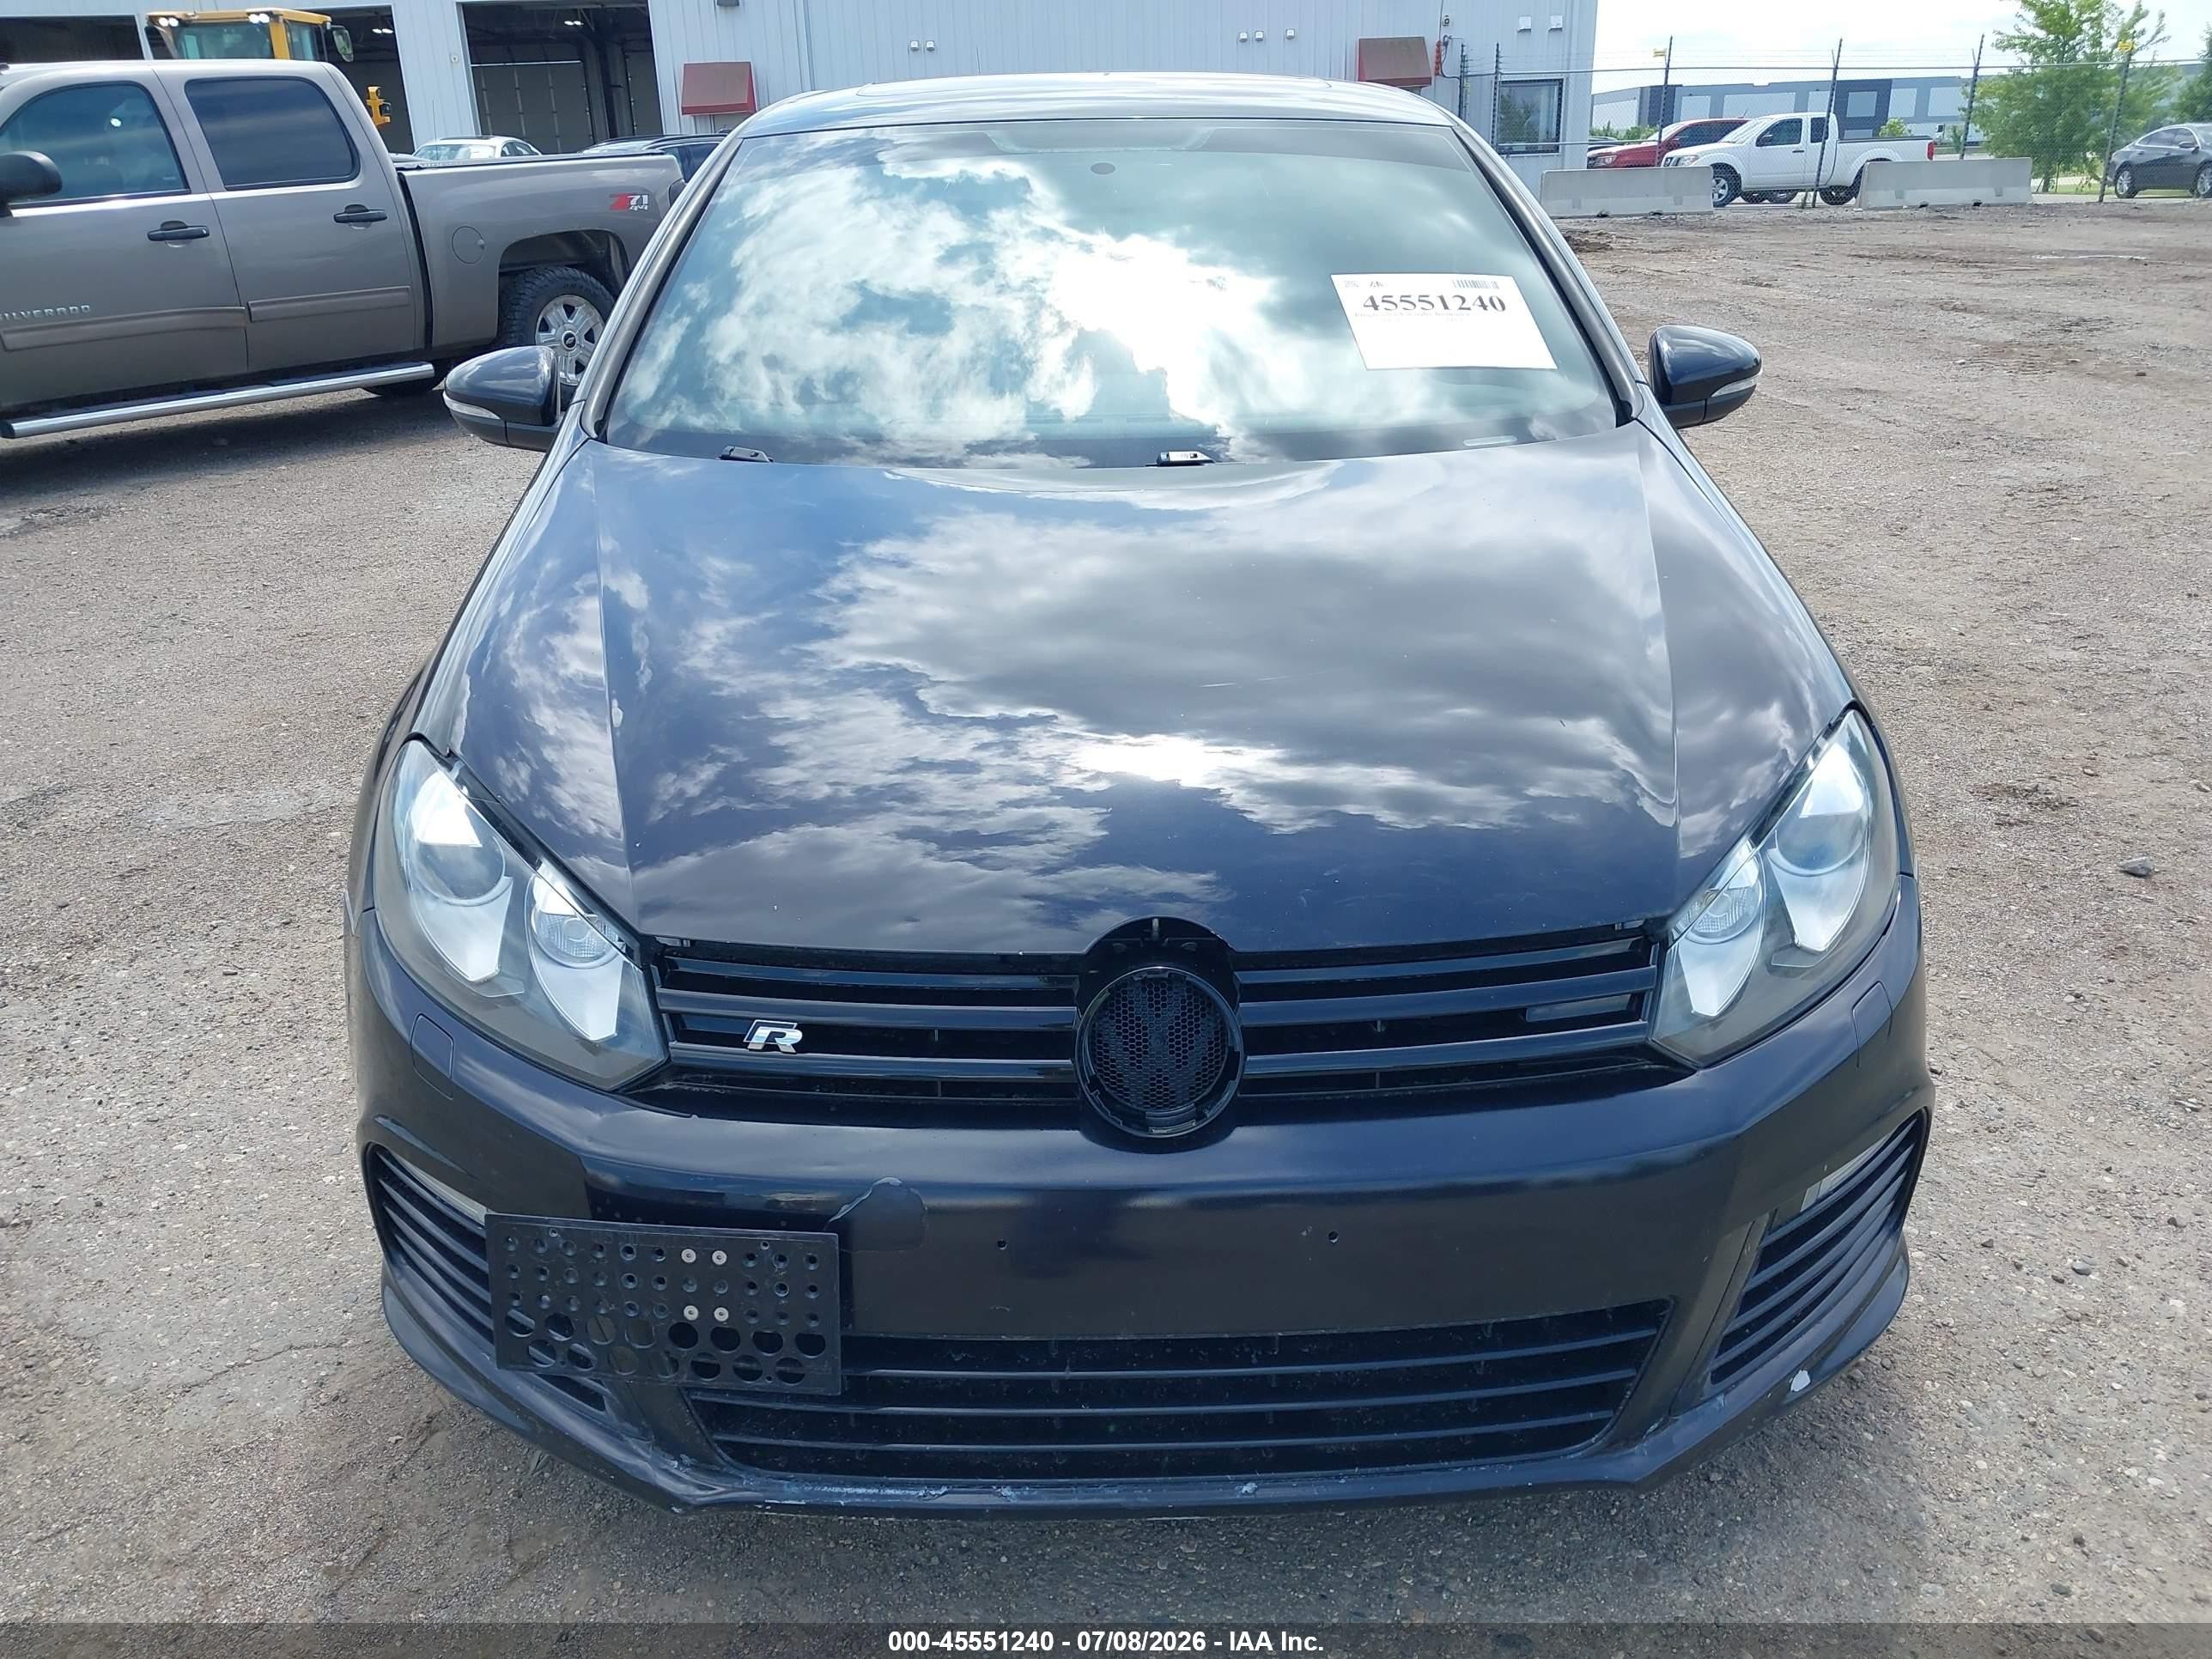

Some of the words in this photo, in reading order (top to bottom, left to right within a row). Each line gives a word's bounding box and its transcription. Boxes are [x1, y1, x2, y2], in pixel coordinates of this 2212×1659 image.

[609, 192, 649, 212] Z71
[1363, 295, 1506, 312] 45551240
[743, 1019, 803, 1054] R
